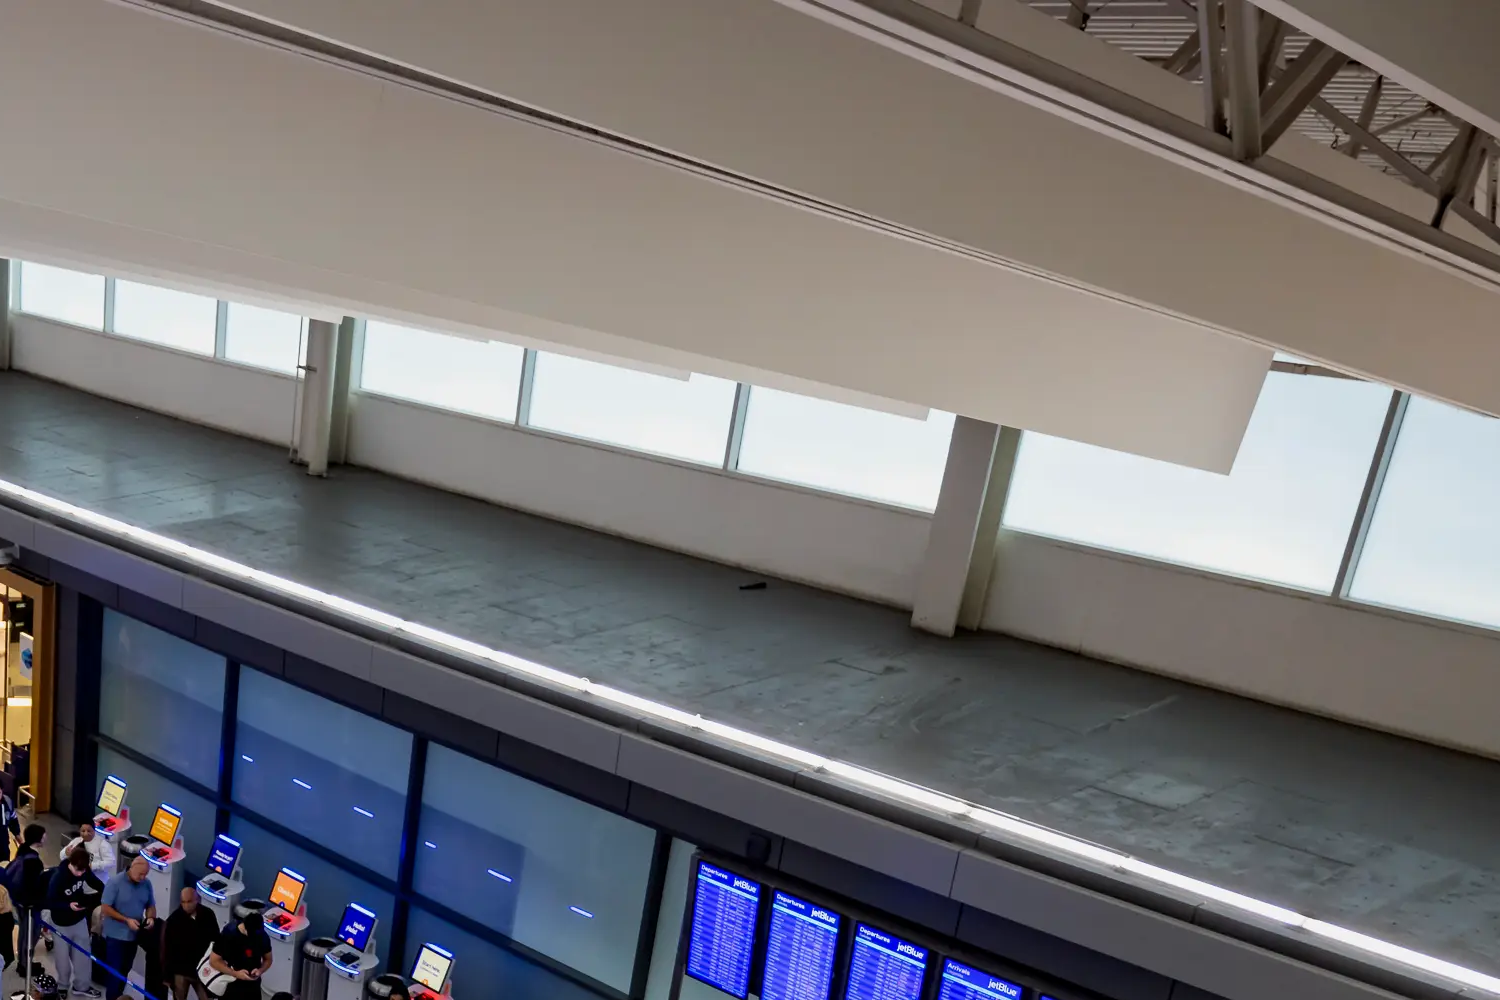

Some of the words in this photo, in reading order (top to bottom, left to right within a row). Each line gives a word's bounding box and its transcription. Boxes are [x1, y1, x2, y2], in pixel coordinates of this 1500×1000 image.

[701, 864, 728, 880] Departures
[733, 877, 757, 893] jetBlue
[776, 893, 805, 910] Departures
[811, 907, 836, 924] jetBlue
[860, 926, 890, 943] Departures
[896, 941, 924, 959] jetBlue
[947, 962, 970, 976] Arrivals
[987, 978, 1017, 997] jetBlue
